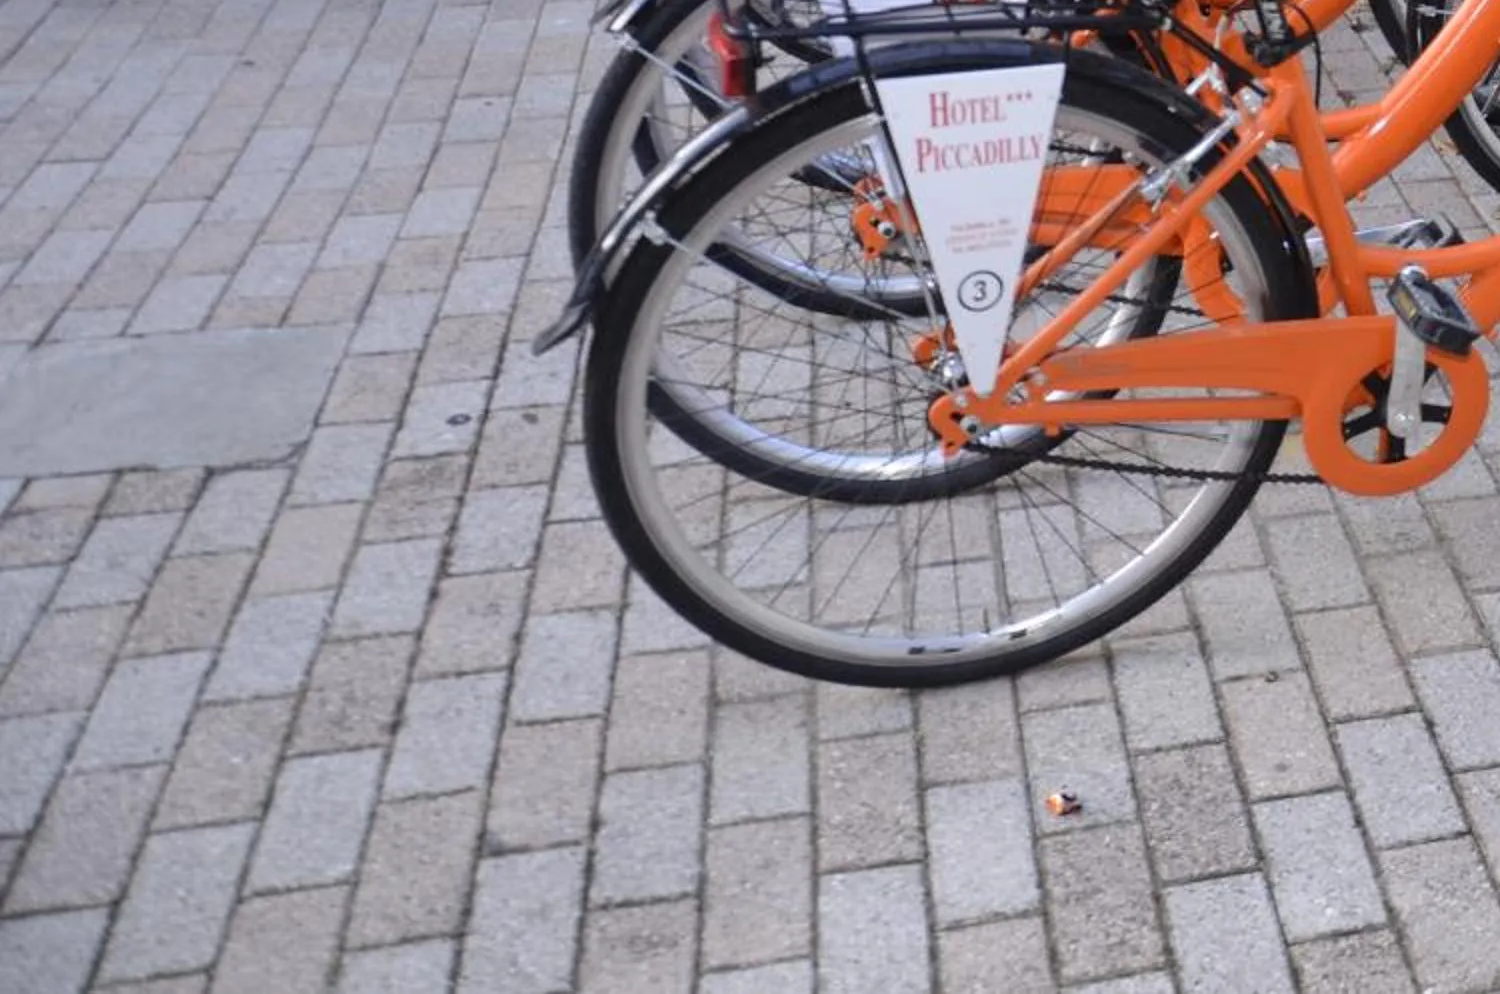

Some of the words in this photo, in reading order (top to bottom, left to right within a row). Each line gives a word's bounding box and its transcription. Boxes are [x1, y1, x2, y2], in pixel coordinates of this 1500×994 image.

[928, 91, 1007, 128] HOTEL
[915, 134, 1044, 173] PICCADILLY
[973, 279, 988, 302] 3
